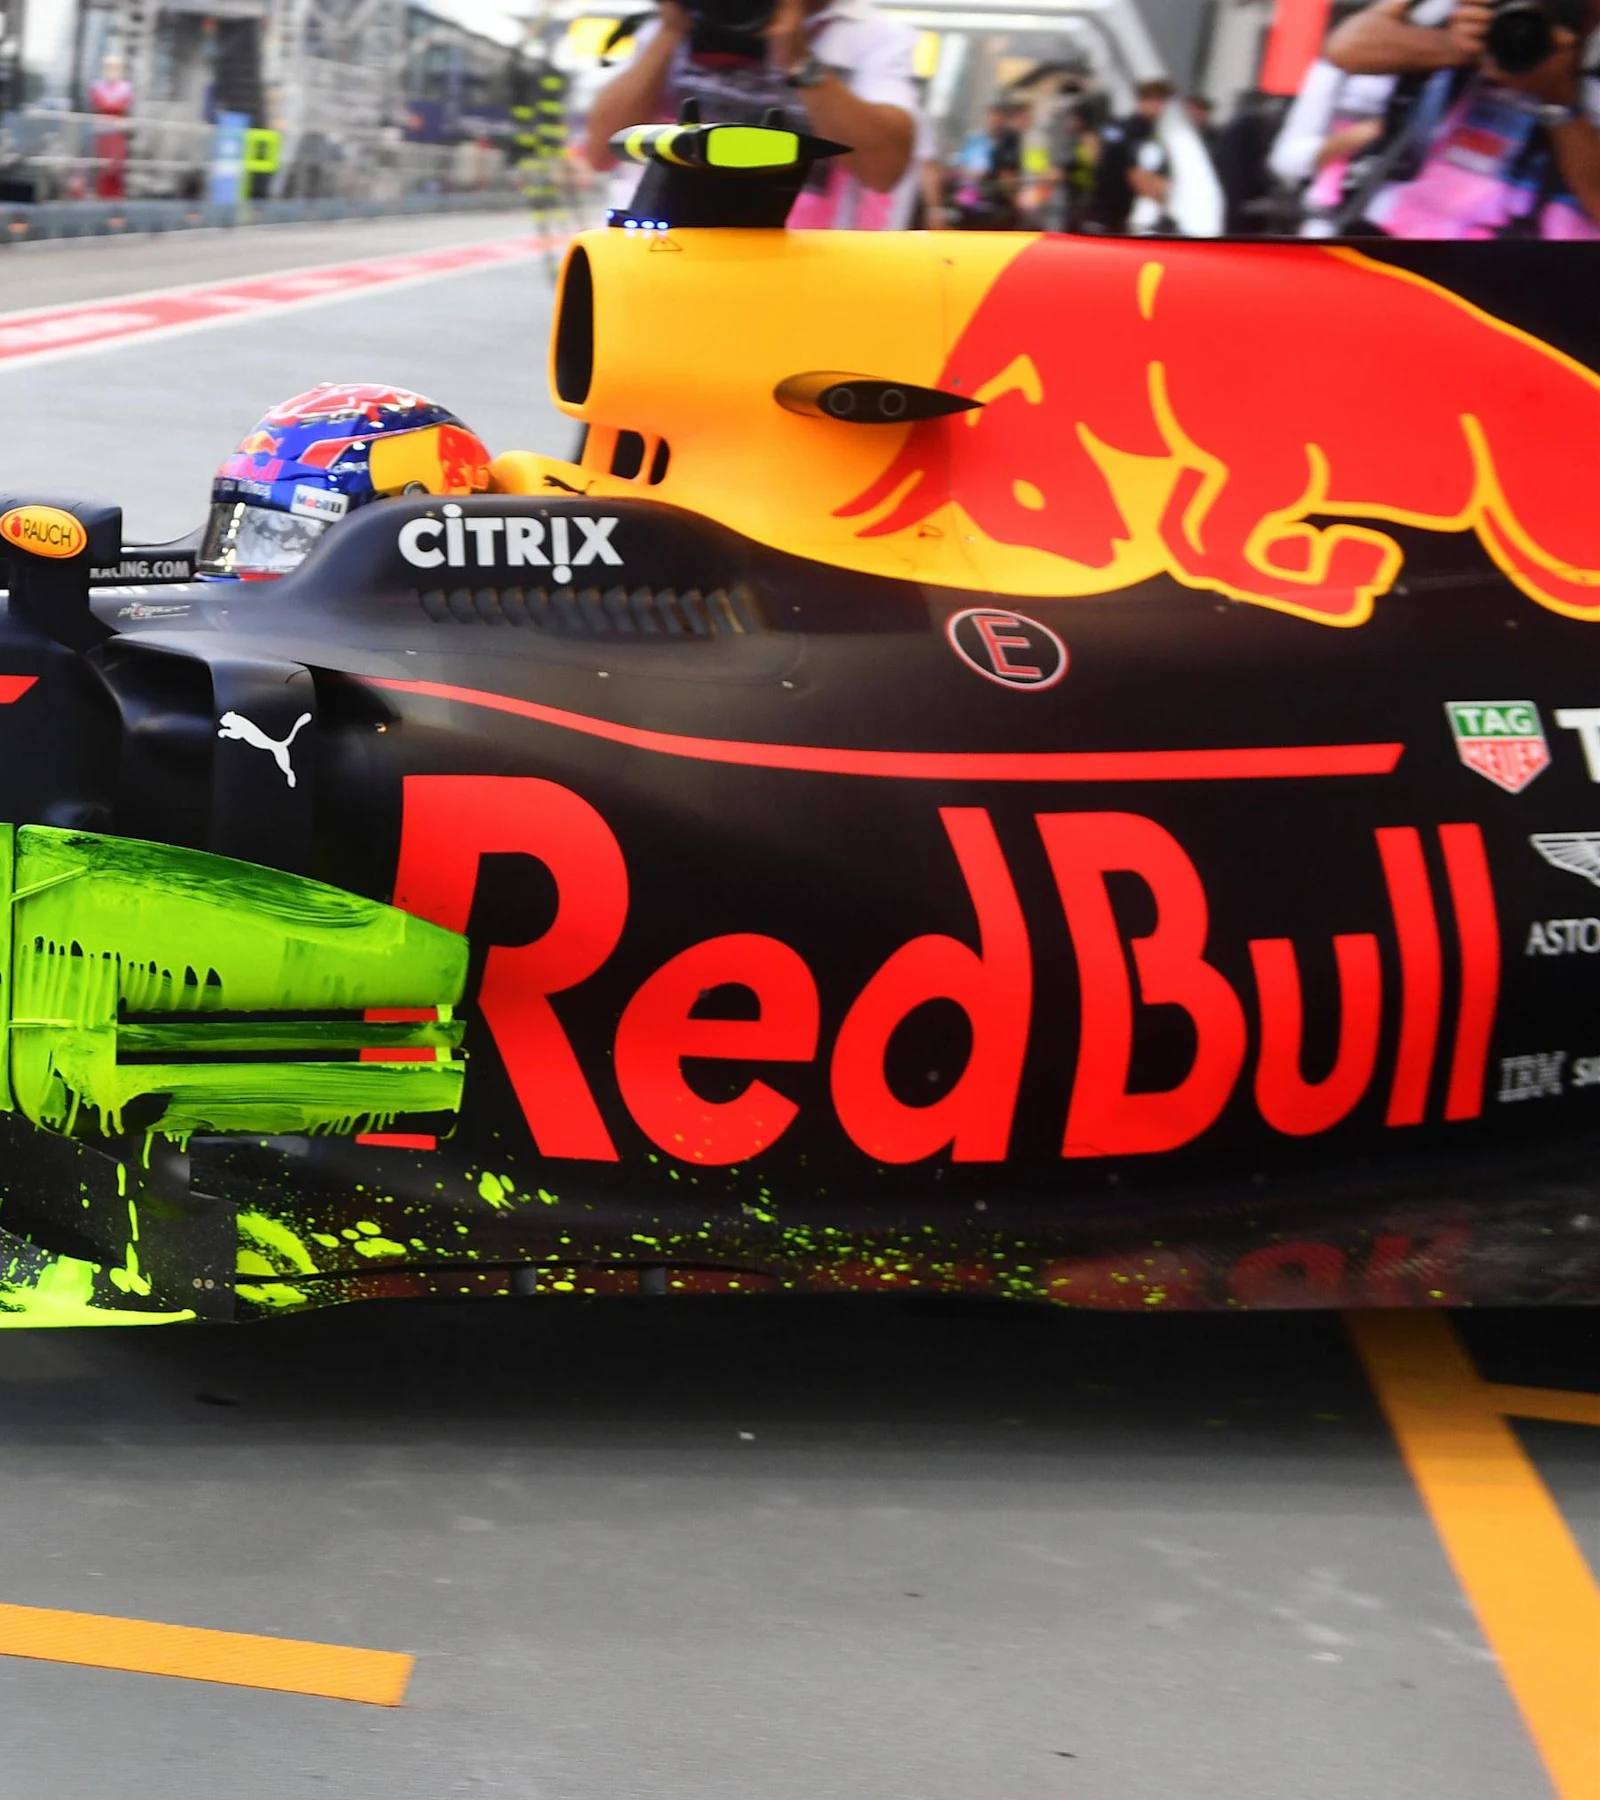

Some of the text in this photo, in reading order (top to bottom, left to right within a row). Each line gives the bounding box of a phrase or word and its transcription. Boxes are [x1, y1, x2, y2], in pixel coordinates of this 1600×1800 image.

[23, 519, 71, 548] RAUCH
[398, 503, 624, 584] CITRIX
[971, 615, 1043, 679] E
[1455, 707, 1534, 735] TAG
